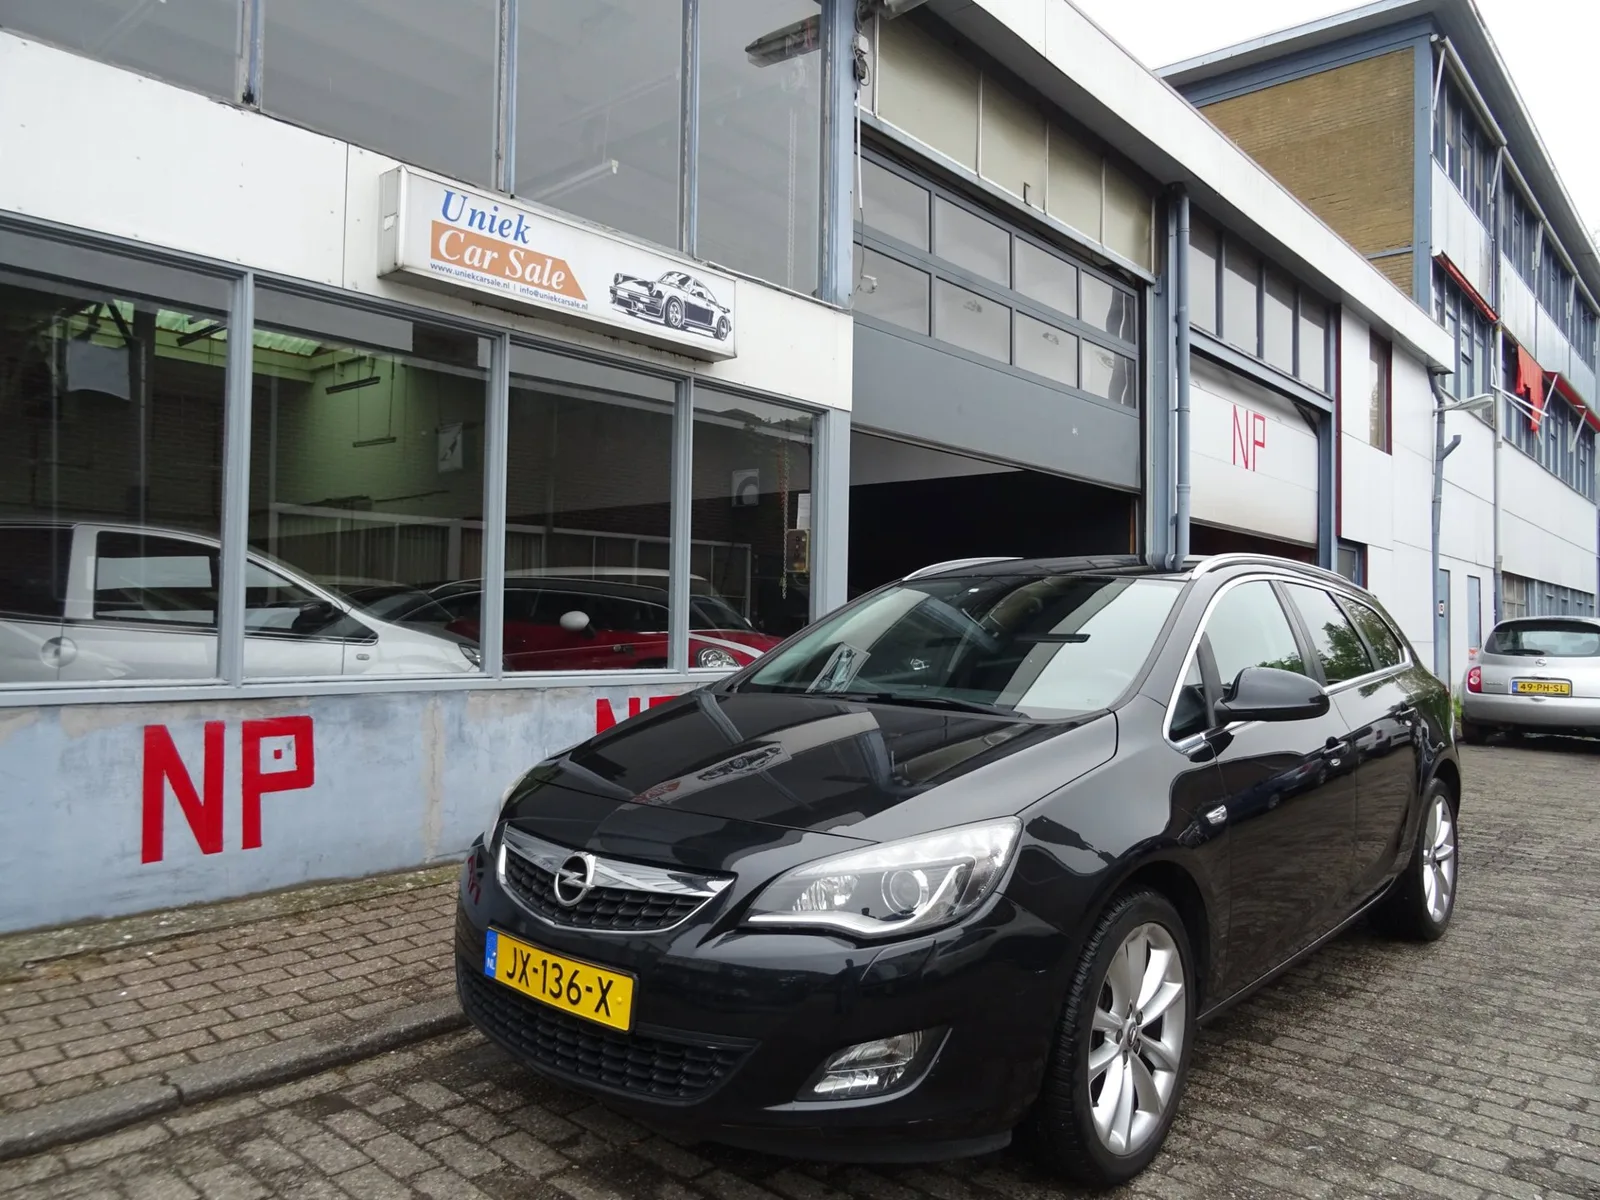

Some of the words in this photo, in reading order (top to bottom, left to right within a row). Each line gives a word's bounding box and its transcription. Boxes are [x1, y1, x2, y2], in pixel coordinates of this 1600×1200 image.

[441, 189, 531, 244] Uniek
[430, 262, 510, 289] www.uniekcarsale.nl
[519, 285, 588, 310] info@uniekcarsale.nl
[438, 229, 499, 270] Car
[505, 248, 566, 290] Sale
[1232, 403, 1265, 472] NP
[1519, 682, 1566, 693] 49-PH-SL
[141, 715, 315, 865] NP
[486, 957, 496, 970] NL
[506, 946, 614, 1018] JX-136-X
